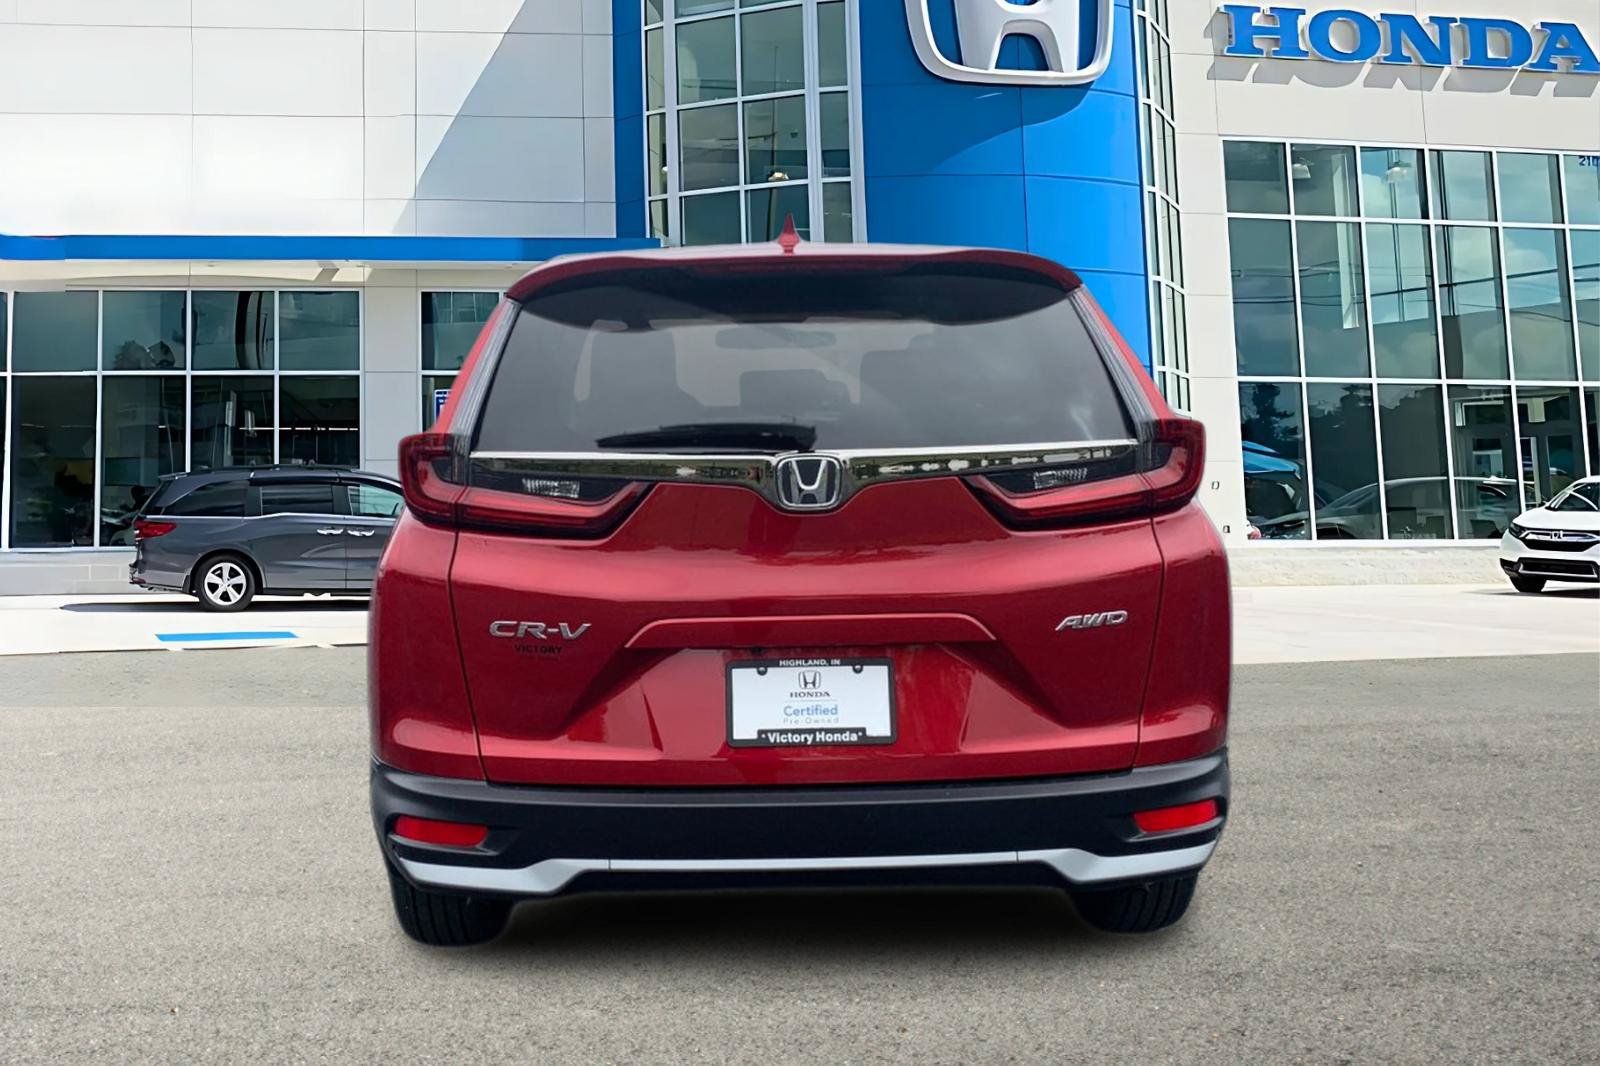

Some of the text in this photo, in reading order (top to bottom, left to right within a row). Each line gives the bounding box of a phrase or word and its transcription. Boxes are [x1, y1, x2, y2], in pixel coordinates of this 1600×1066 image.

[1223, 4, 1600, 74] HONDA
[1055, 610, 1128, 631] AWD
[489, 620, 592, 639] CR-V
[514, 644, 562, 654] VICTORY
[831, 658, 841, 666] IN
[783, 704, 838, 717] Certified
[767, 731, 858, 745] Victory Honda
